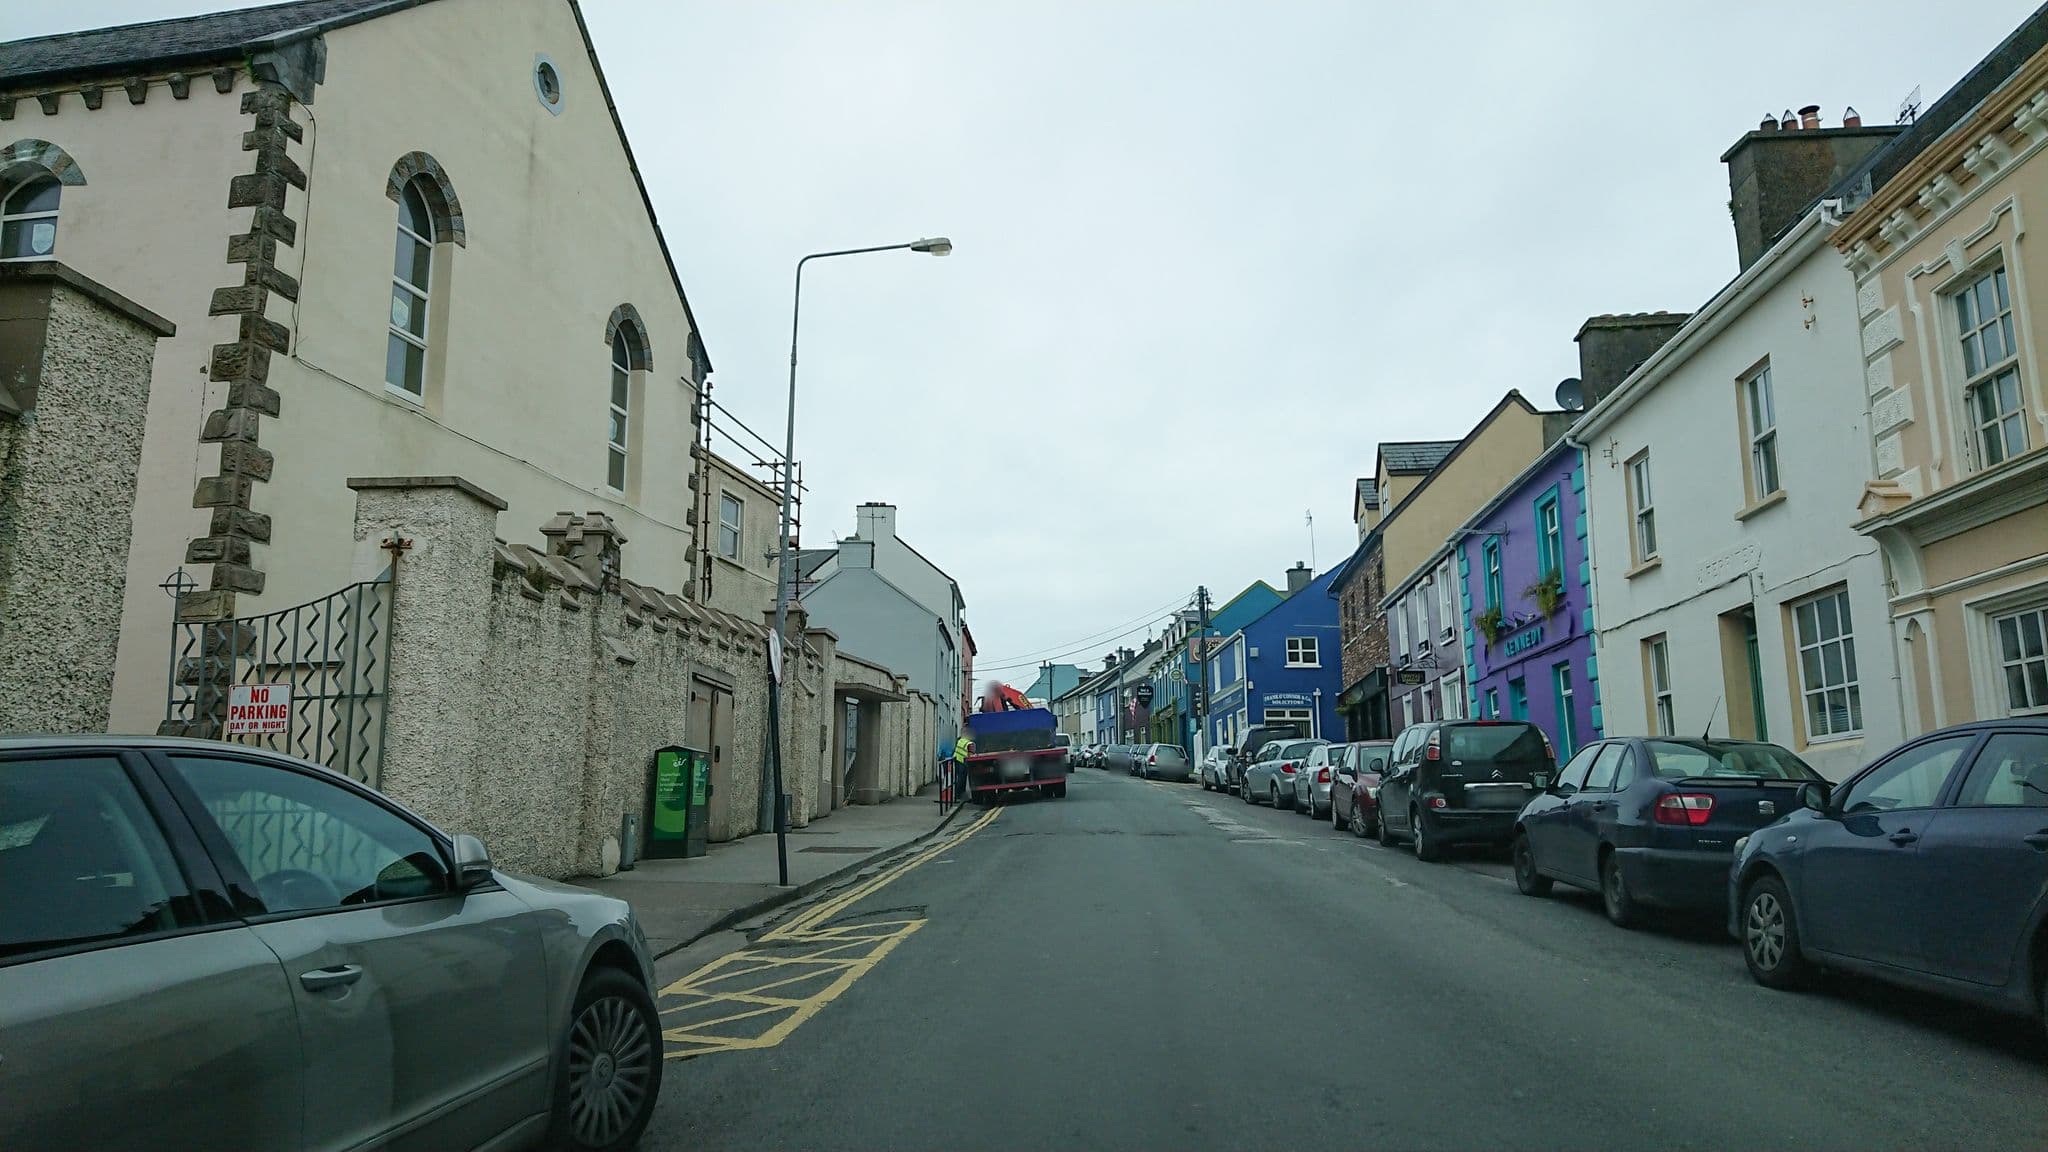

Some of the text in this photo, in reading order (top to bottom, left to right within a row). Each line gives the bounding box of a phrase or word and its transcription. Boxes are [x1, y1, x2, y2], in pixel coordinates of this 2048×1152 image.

[1504, 626, 1544, 657] KENNEDY
[250, 688, 269, 703] NO
[230, 704, 287, 720] PARKING
[230, 722, 245, 730] DAY
[262, 720, 286, 729] NIGHT
